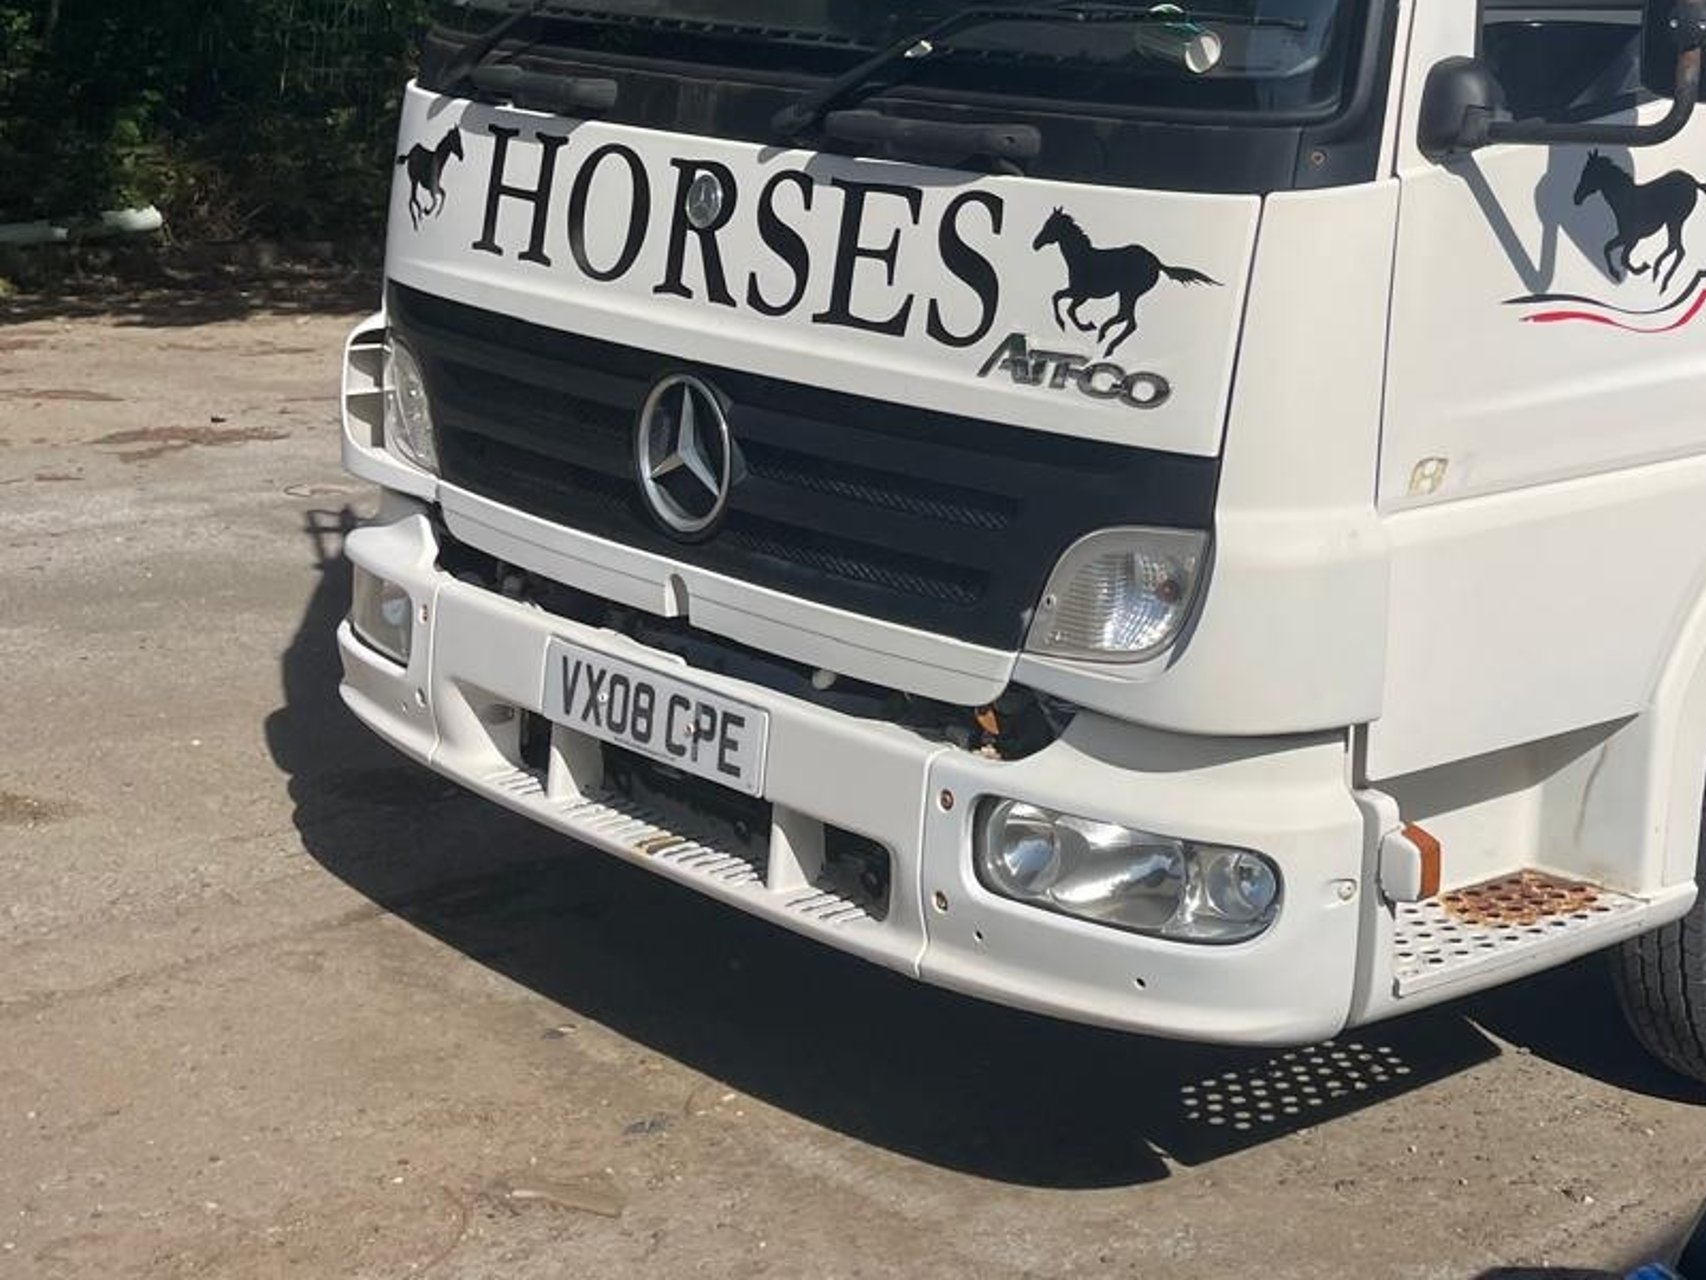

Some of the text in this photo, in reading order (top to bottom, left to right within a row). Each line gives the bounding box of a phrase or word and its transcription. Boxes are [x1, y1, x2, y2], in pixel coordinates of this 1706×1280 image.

[472, 123, 1003, 347] HORSES
[562, 655, 745, 778] VX08 CPE
